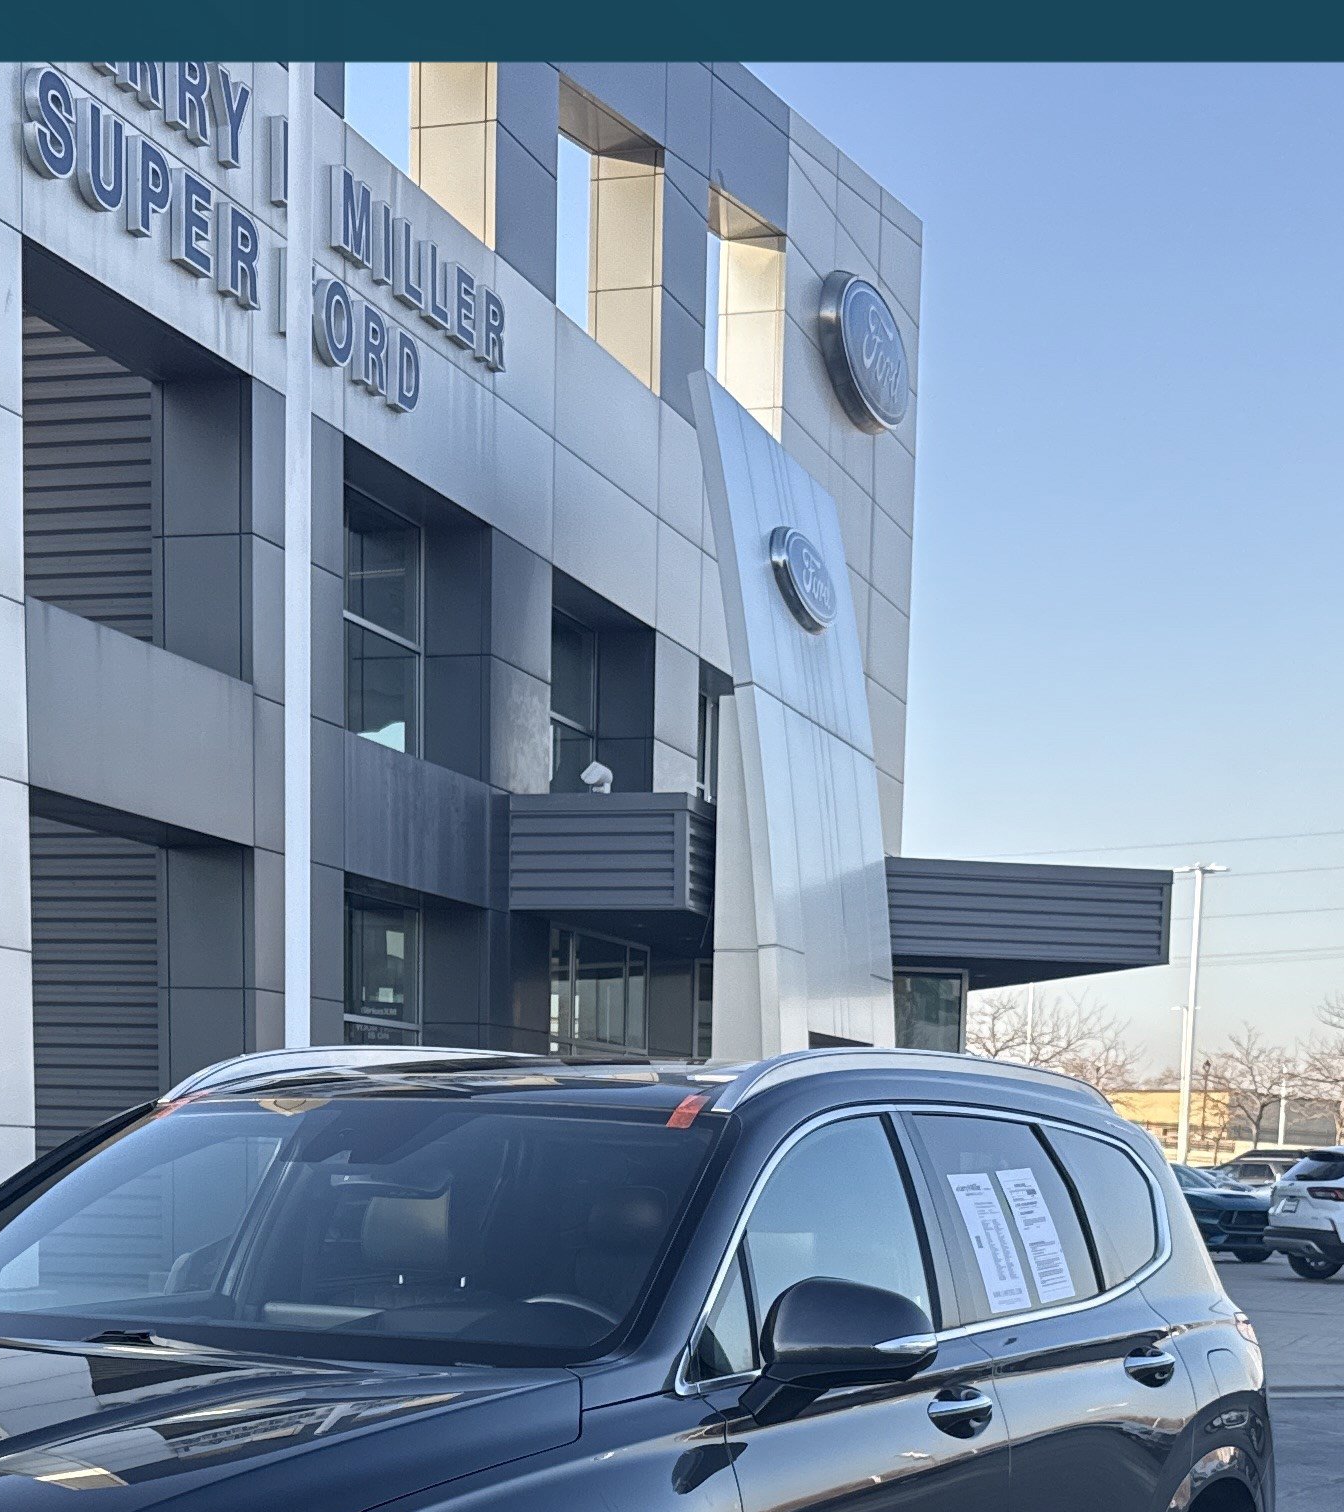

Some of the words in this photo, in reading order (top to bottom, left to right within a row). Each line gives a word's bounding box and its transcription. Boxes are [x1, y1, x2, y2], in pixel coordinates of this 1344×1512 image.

[24, 67, 260, 310] SUPER
[279, 246, 420, 413] ORD
[330, 163, 505, 373] MILLER
